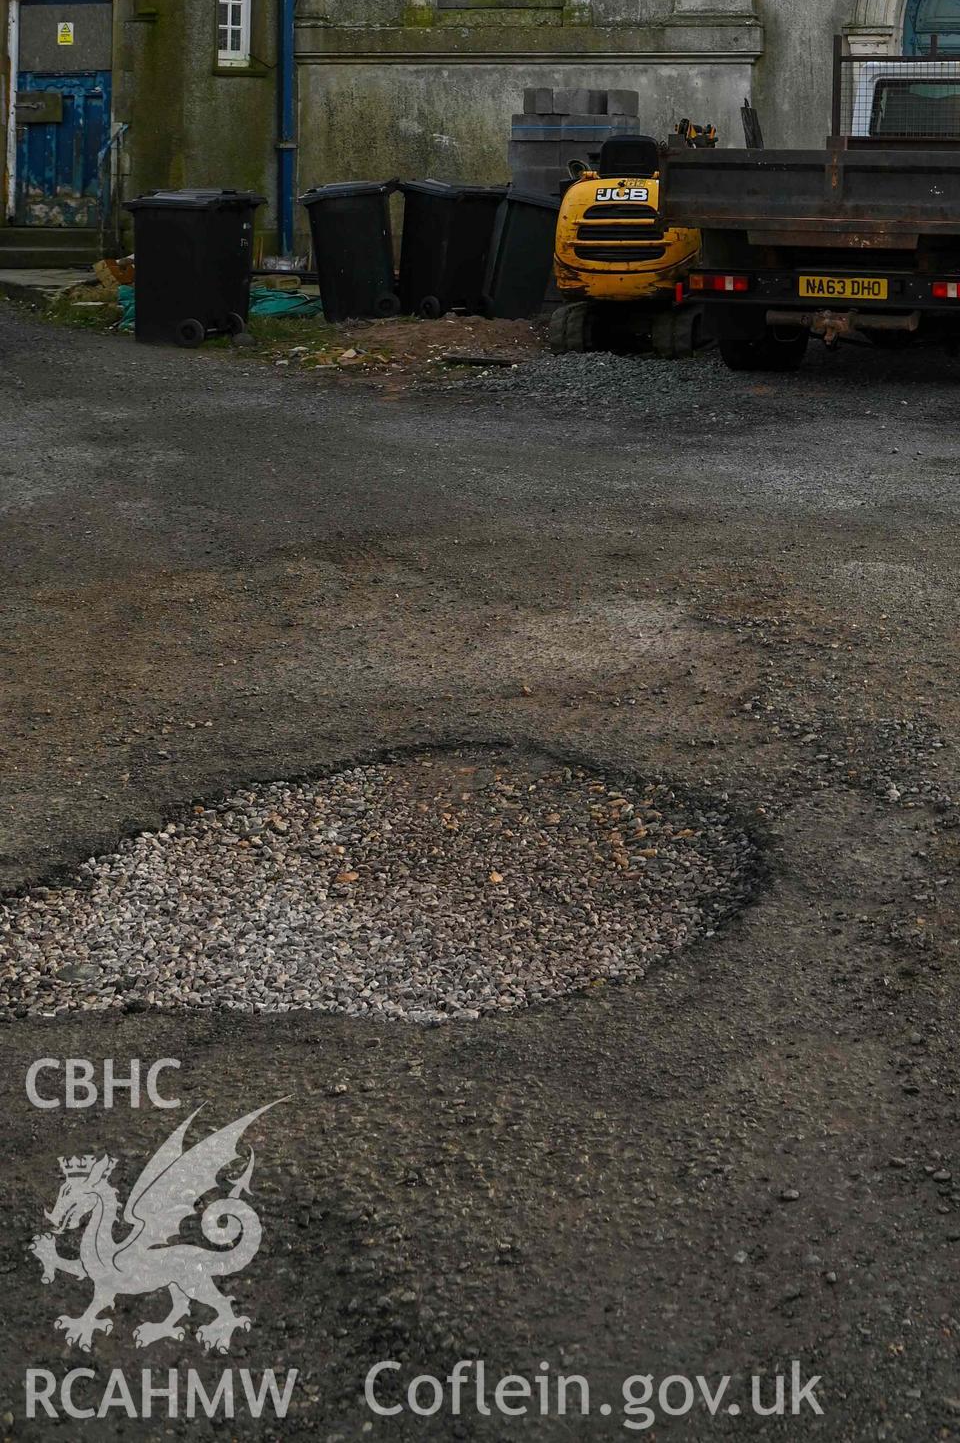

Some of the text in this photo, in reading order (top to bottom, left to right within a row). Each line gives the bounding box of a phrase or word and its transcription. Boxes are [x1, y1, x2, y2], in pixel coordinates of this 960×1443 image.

[597, 188, 648, 201] JCB
[806, 279, 881, 296] NA63 DHO
